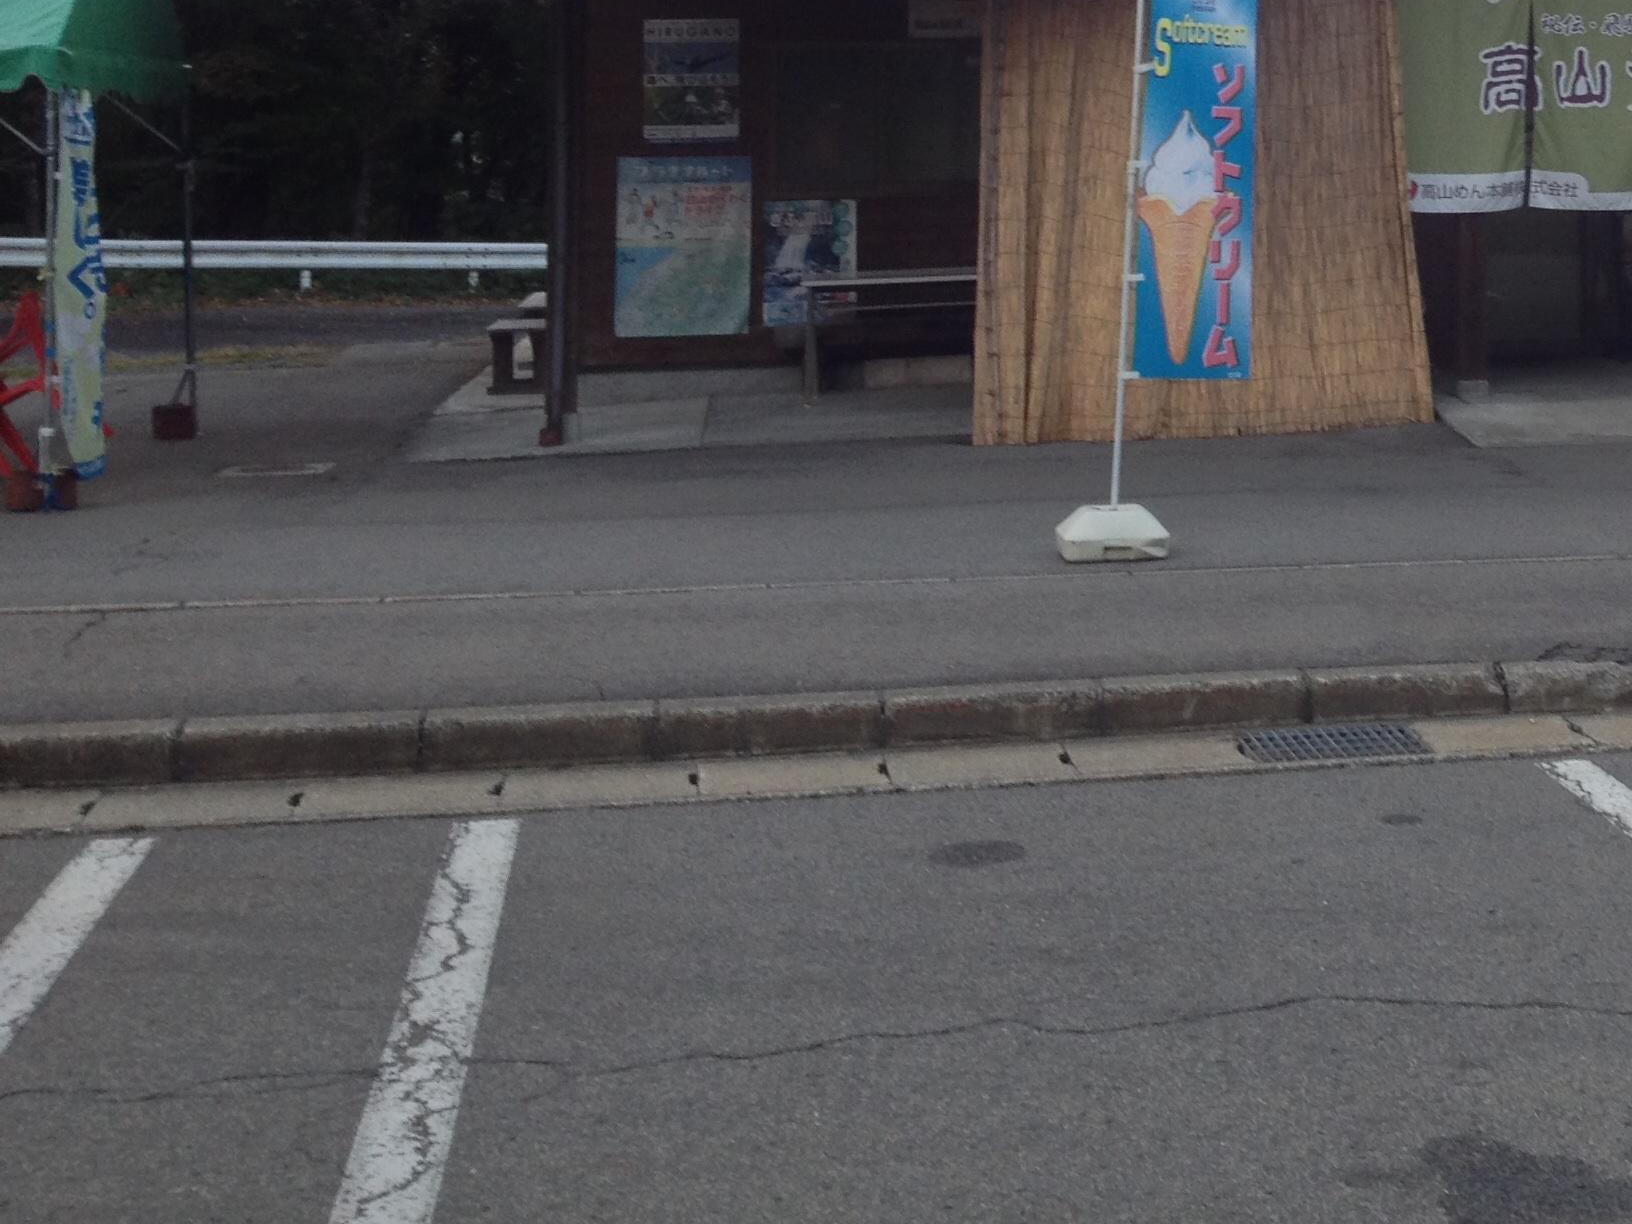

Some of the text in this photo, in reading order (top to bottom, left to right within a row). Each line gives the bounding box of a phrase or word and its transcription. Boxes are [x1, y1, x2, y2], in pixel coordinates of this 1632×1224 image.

[1200, 62, 1245, 370] ソフトクリーム
